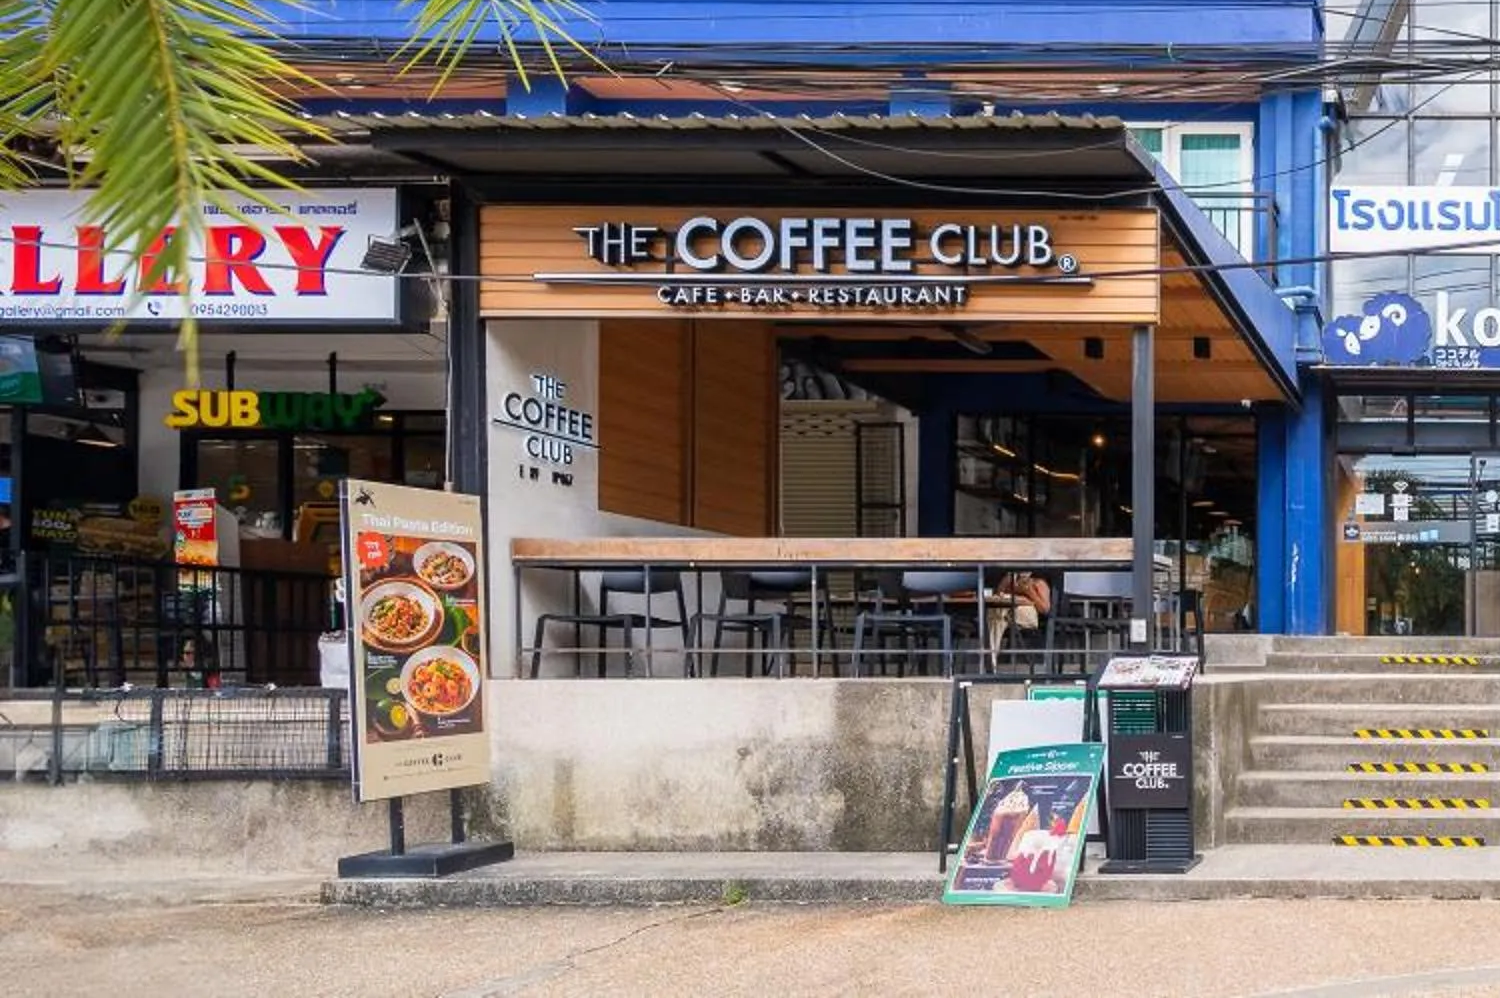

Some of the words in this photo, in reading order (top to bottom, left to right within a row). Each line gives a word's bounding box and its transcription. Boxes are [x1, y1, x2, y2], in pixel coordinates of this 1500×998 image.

[0, 225, 346, 296] LLERY
[572, 221, 657, 264] THE
[676, 217, 911, 271] COFFEE
[657, 286, 717, 303] CAFE
[741, 286, 786, 303] BAR
[808, 286, 965, 303] RESTAURANT
[532, 374, 568, 400] THE
[164, 387, 388, 430] SUBWAY
[504, 392, 593, 440] COFFEE
[527, 436, 574, 464] CLUB
[1123, 763, 1177, 777] COFFEE
